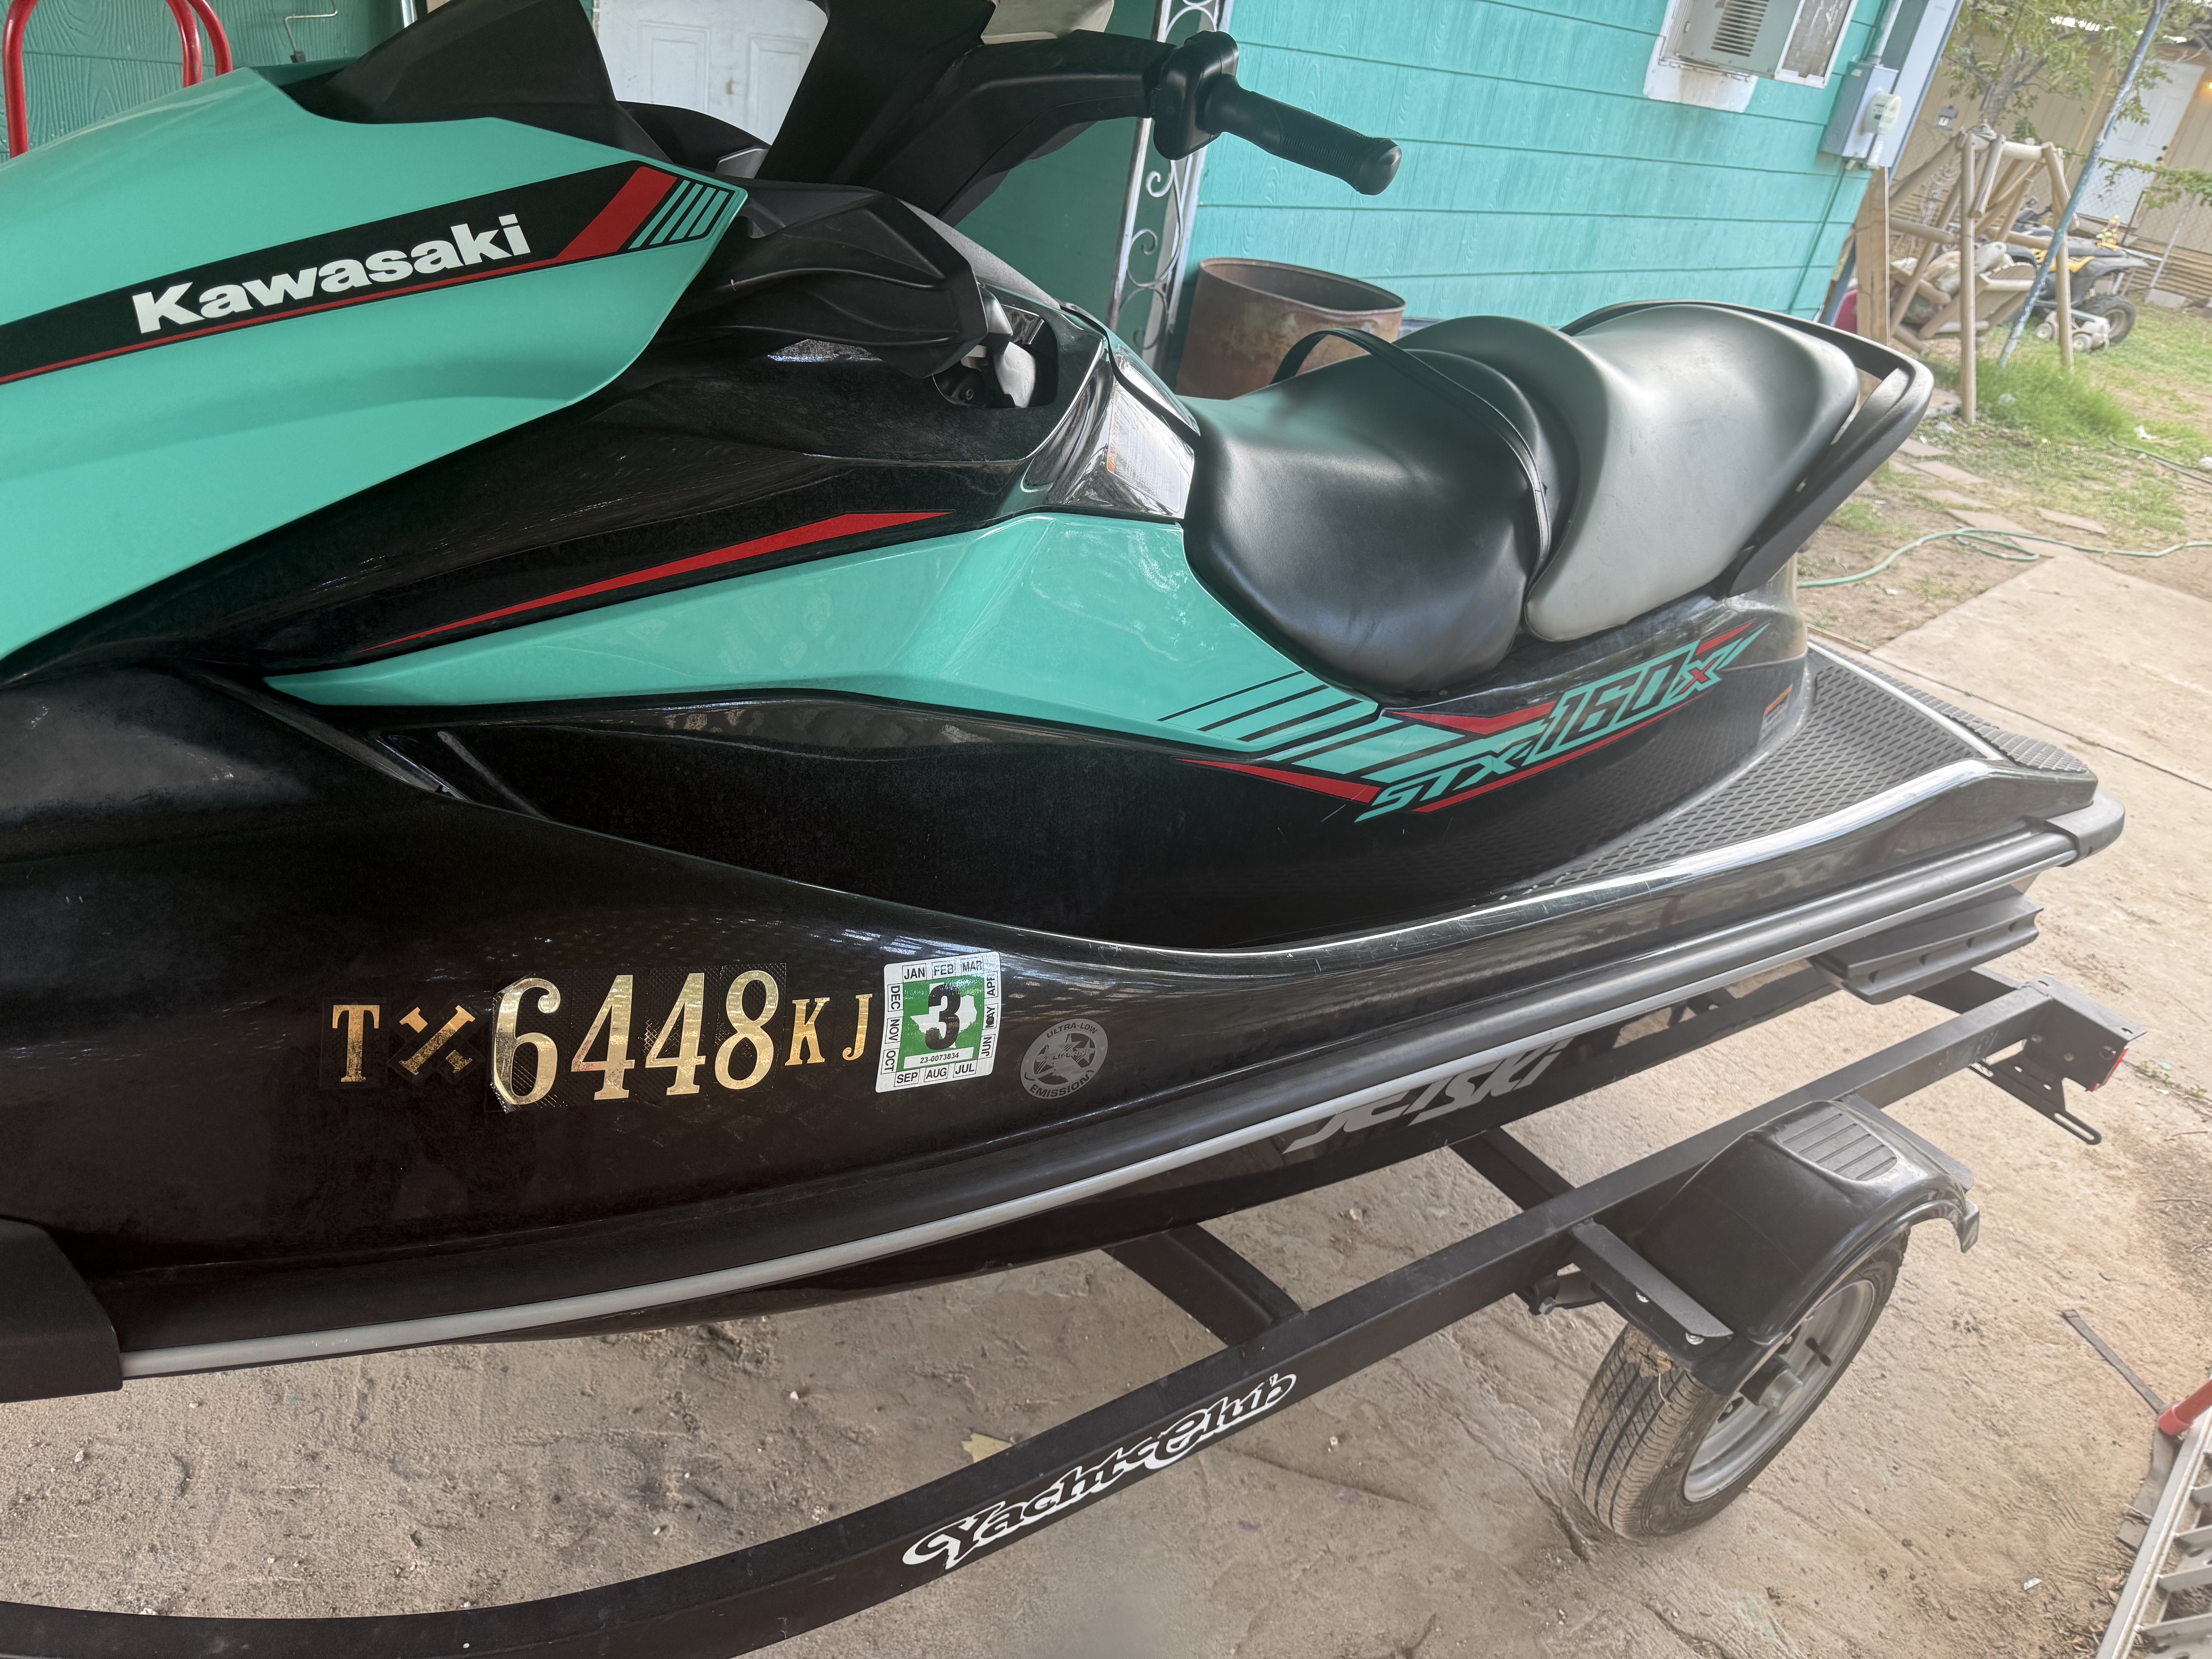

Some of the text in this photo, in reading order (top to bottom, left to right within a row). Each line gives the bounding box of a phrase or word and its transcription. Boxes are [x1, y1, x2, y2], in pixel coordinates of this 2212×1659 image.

[132, 213, 531, 334] Kawasaki
[904, 968, 926, 980] JAN
[934, 963, 954, 976] FEB
[962, 960, 982, 972] MAR
[891, 985, 900, 1010] DEC
[925, 984, 961, 1050] 3
[493, 970, 778, 1105] 6448
[888, 1018, 900, 1041] NOV
[981, 1036, 993, 1056] JUN
[885, 1051, 896, 1072] OCT
[920, 1052, 960, 1064] 23-0073834
[896, 1072, 918, 1084] SEP
[926, 1067, 947, 1079] AUG
[955, 1063, 975, 1075] JUL
[1029, 1074, 1090, 1097] EMISSION
[903, 1373, 1297, 1570] Yacht Club
